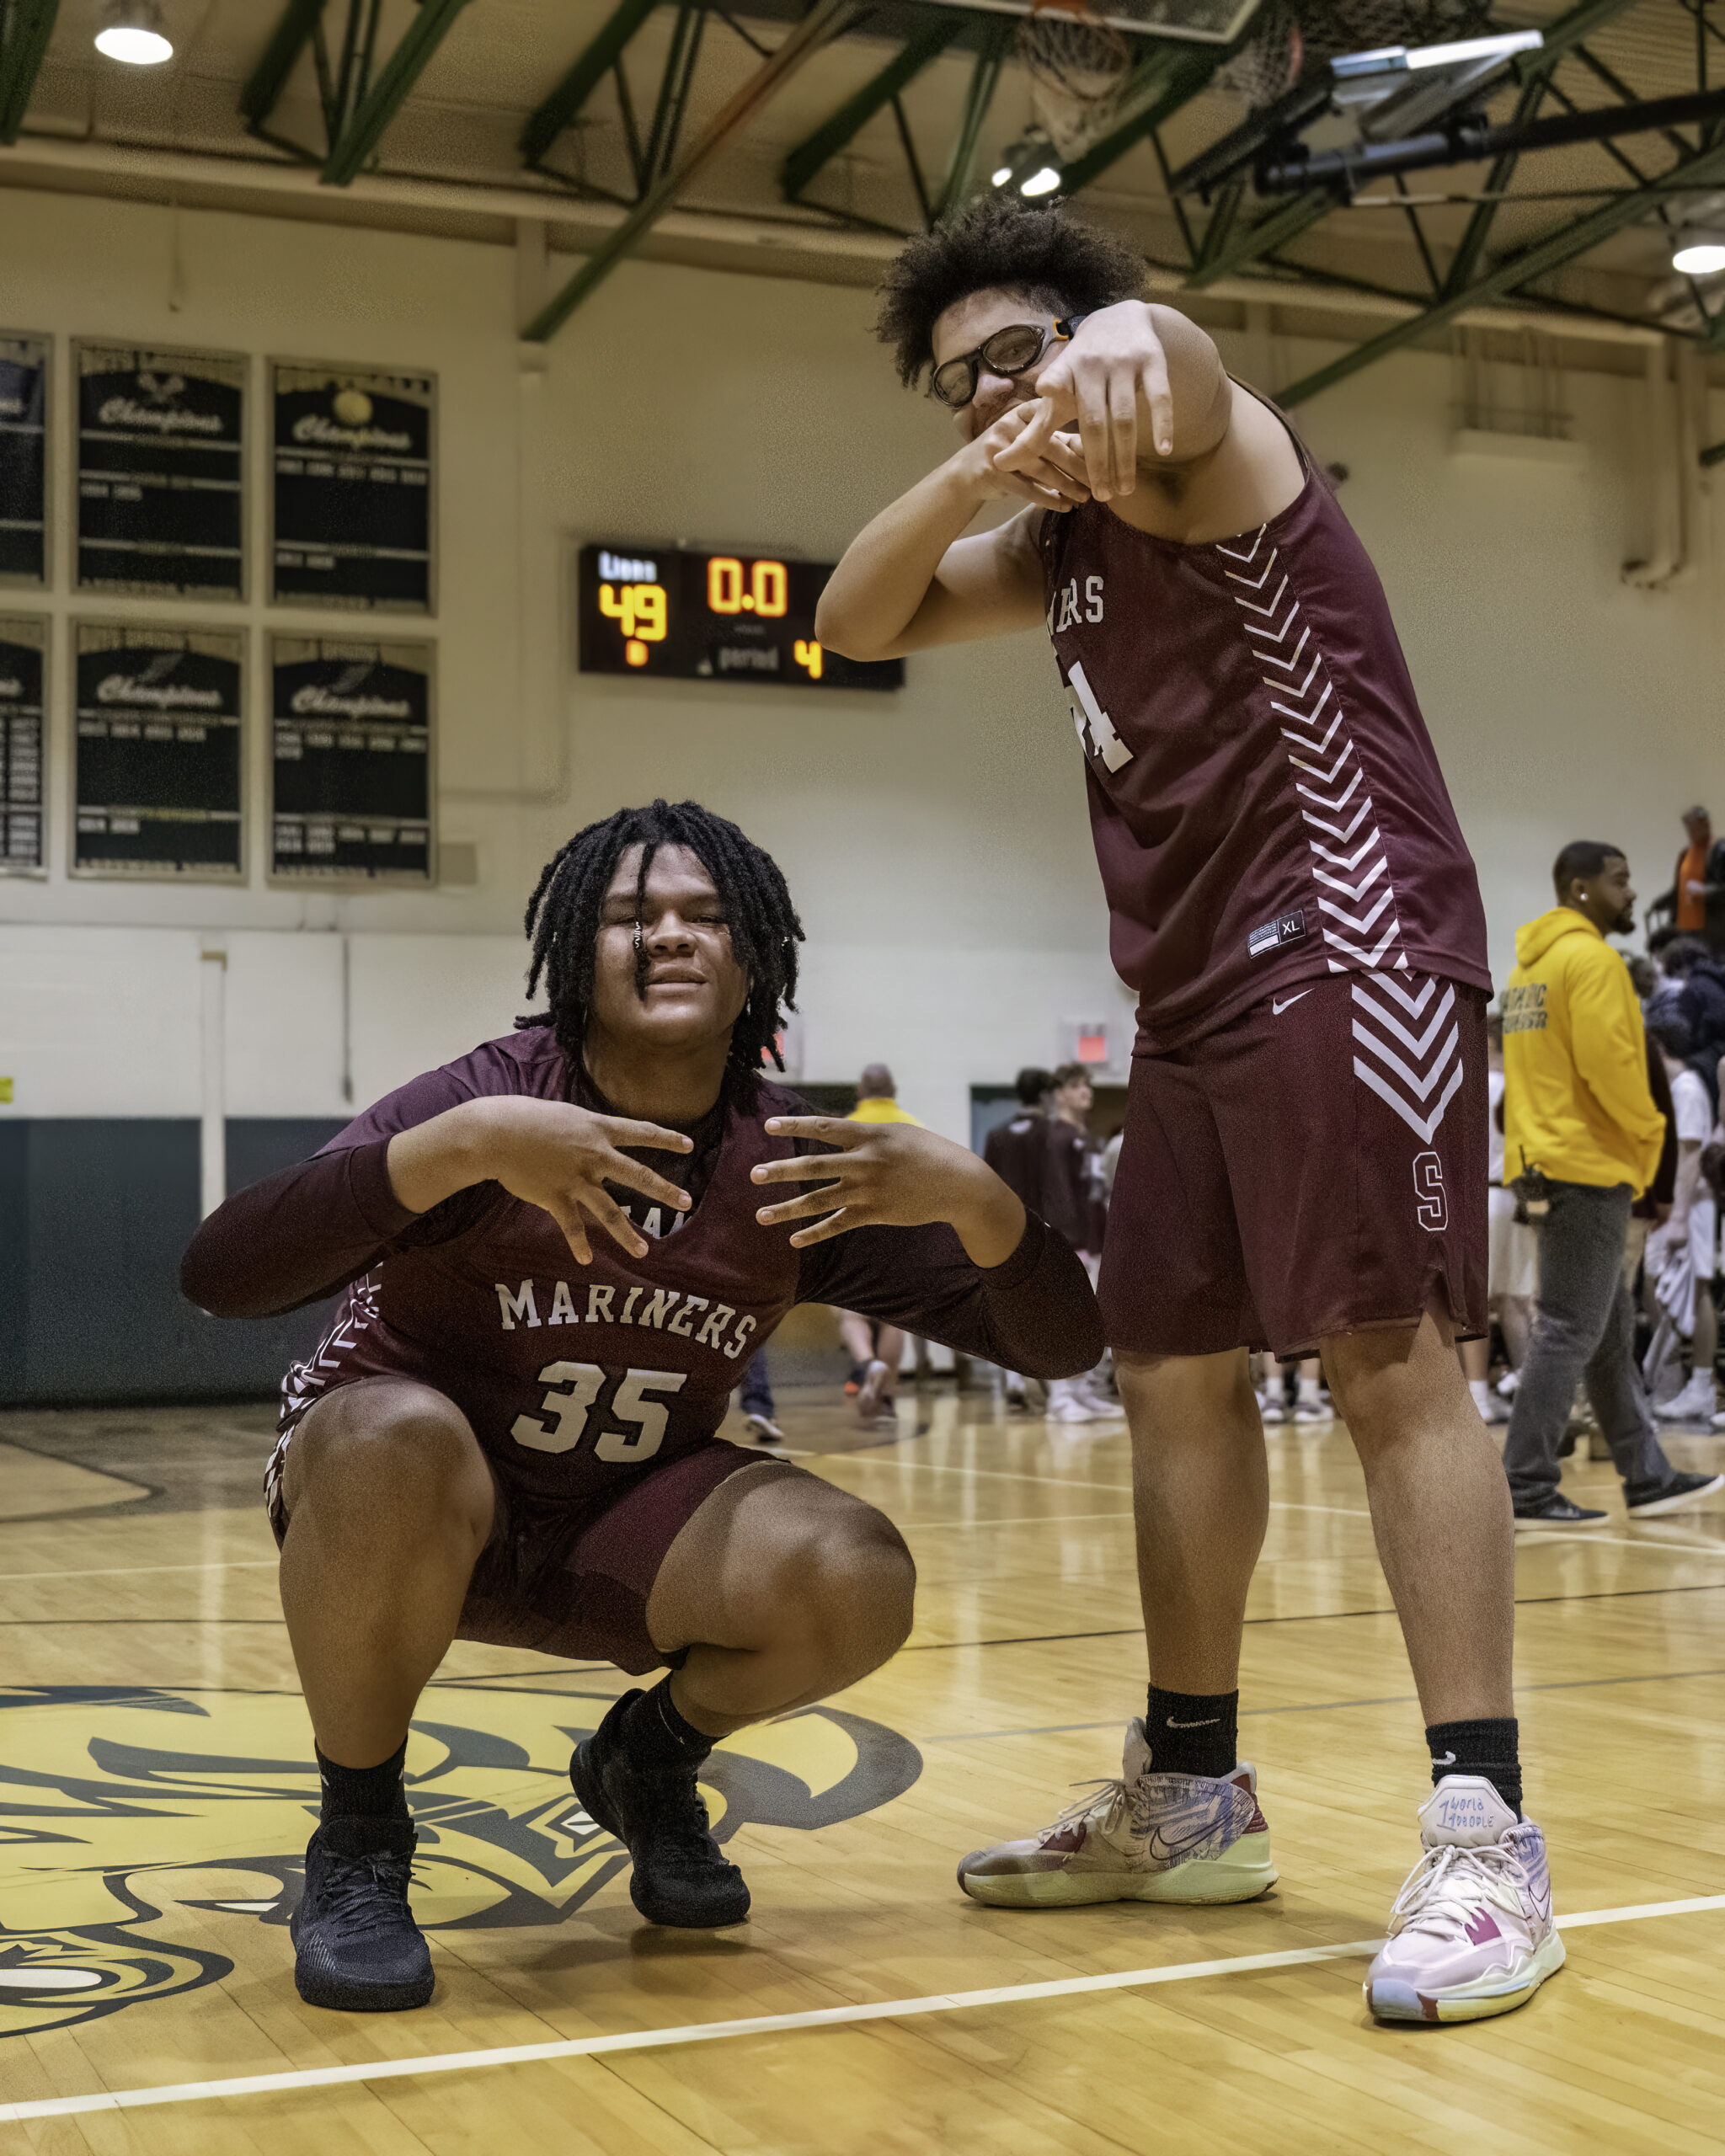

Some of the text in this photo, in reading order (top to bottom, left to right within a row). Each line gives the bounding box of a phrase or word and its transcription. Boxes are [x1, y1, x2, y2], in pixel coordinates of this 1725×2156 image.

[599, 583, 667, 641] 49
[708, 557, 788, 617] 0.0
[1046, 576, 1103, 640] RS
[793, 639, 823, 680] 4
[1065, 660, 1134, 773] 4
[1282, 920, 1300, 935] XL
[1413, 1151, 1448, 1231] S
[495, 1278, 756, 1358] MARINERS
[510, 1361, 687, 1463] 35
